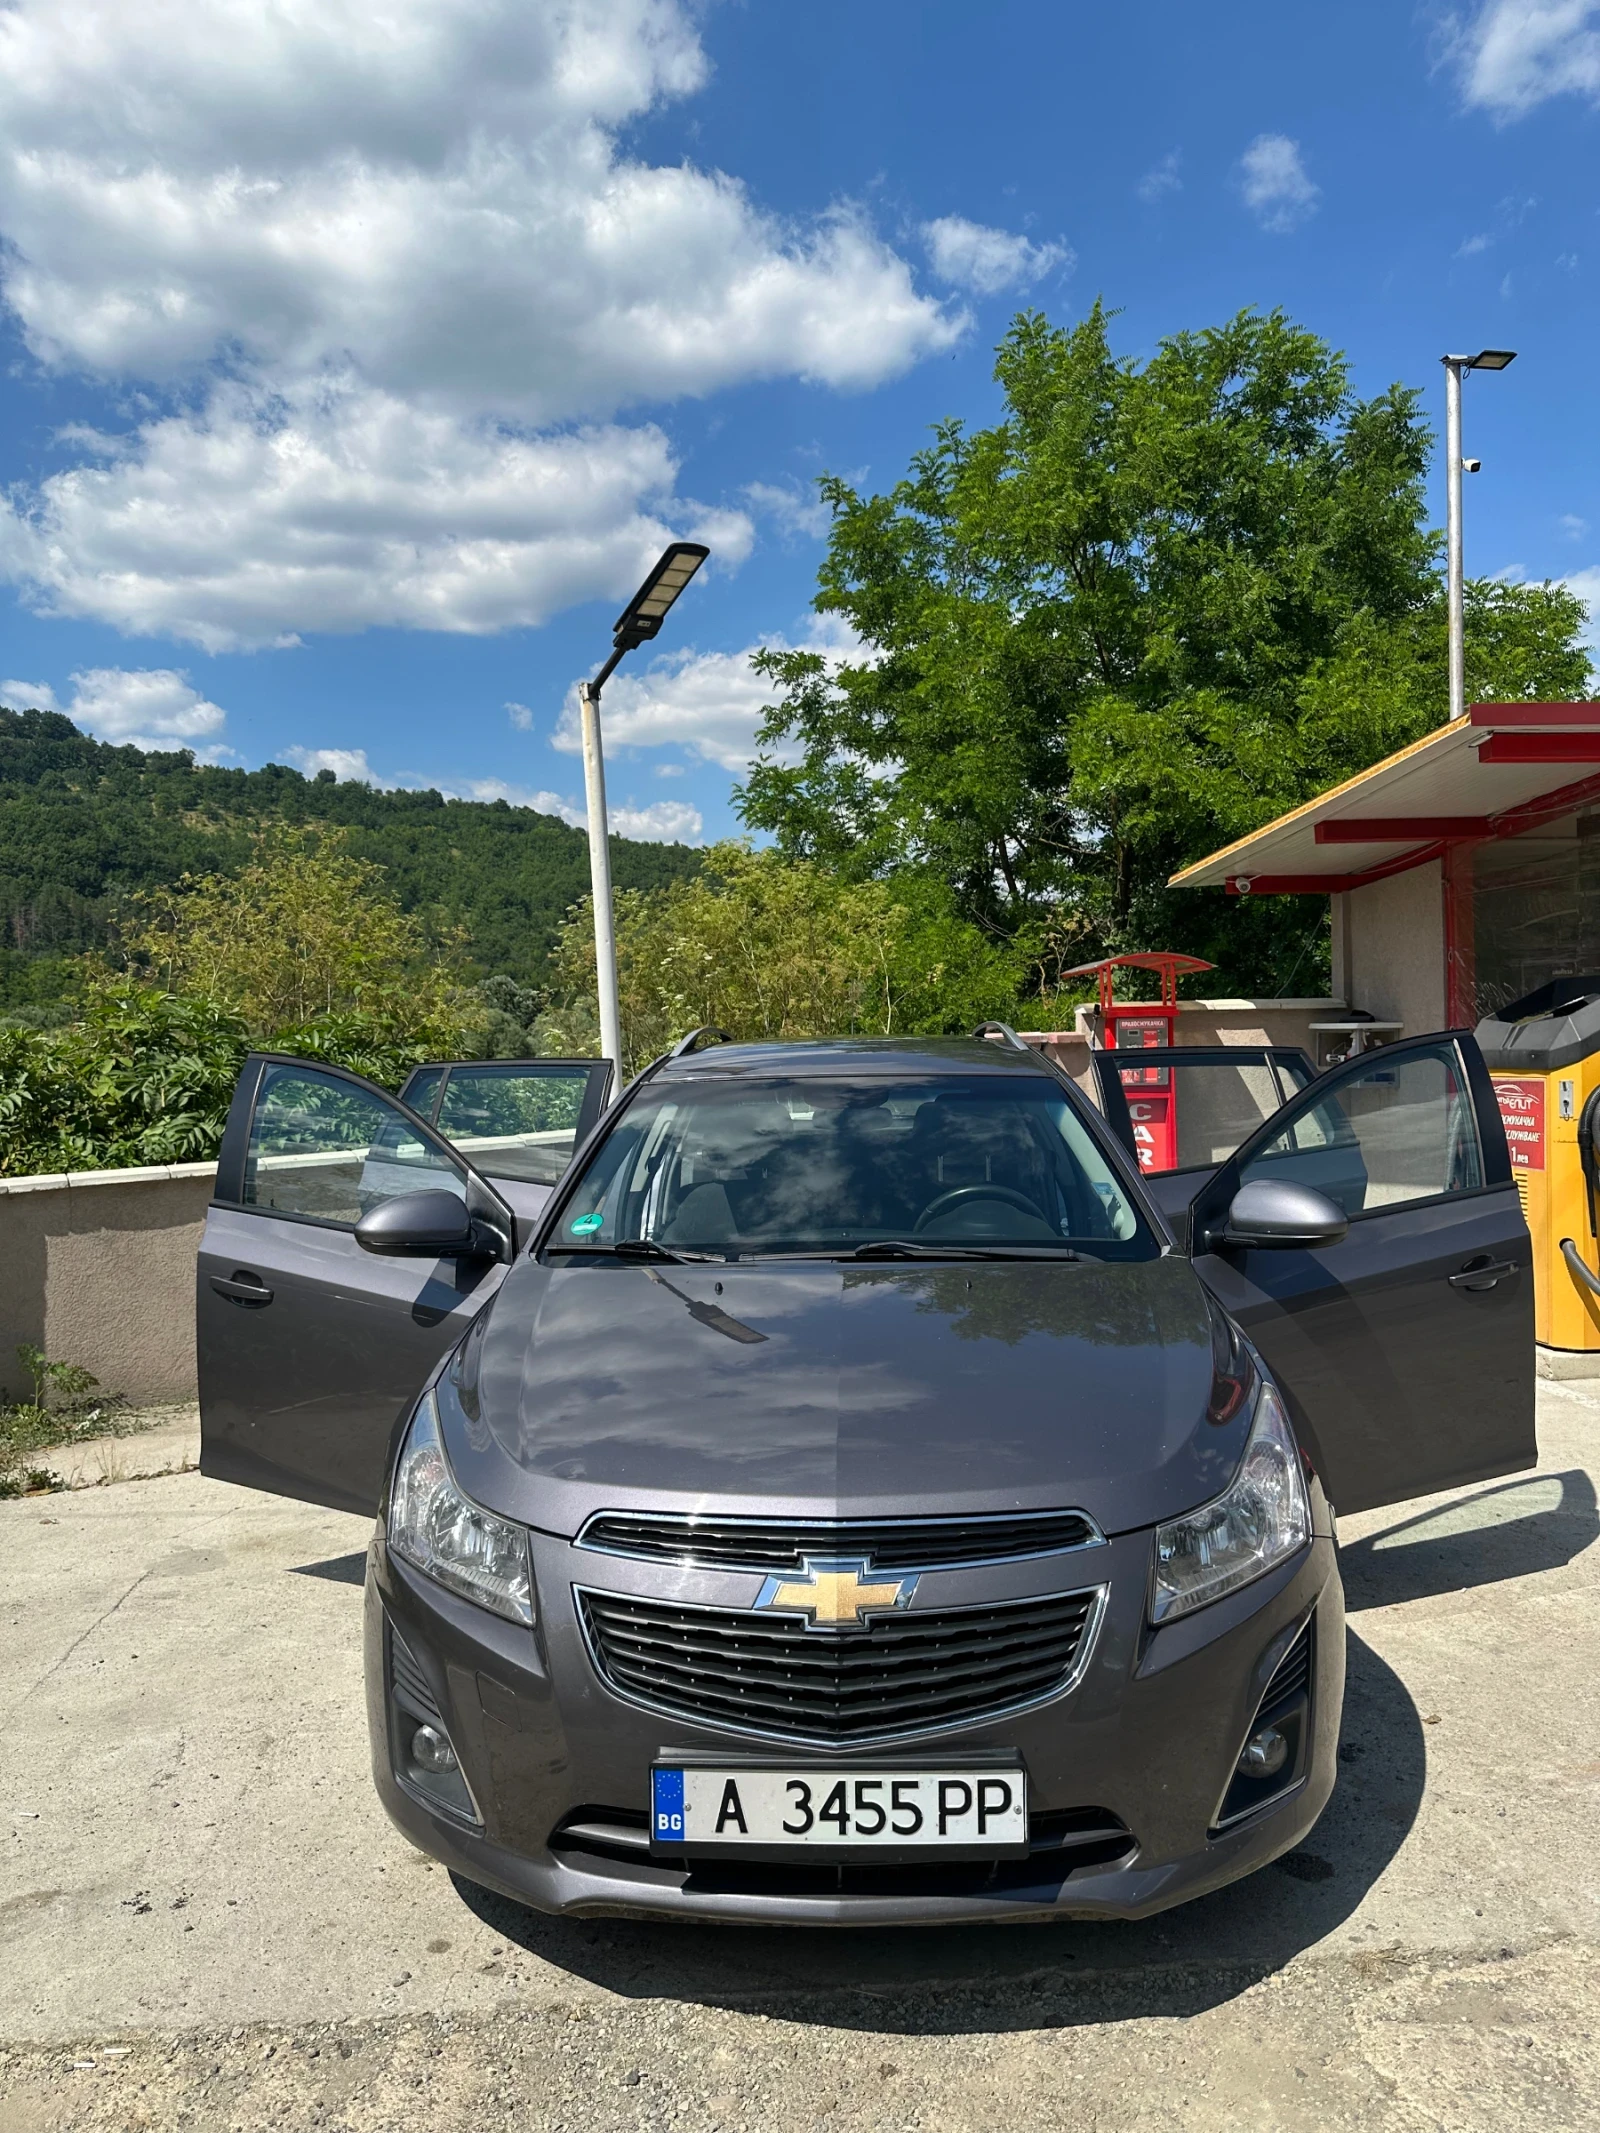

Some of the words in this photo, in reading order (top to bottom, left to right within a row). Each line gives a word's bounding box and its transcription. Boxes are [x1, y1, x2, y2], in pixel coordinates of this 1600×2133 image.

[1511, 1146, 1516, 1162] 1
[584, 1215, 593, 1224] 4
[715, 1778, 748, 1834] A
[782, 1779, 924, 1836] 3455
[938, 1779, 1013, 1836] PP
[658, 1813, 682, 1831] BG
